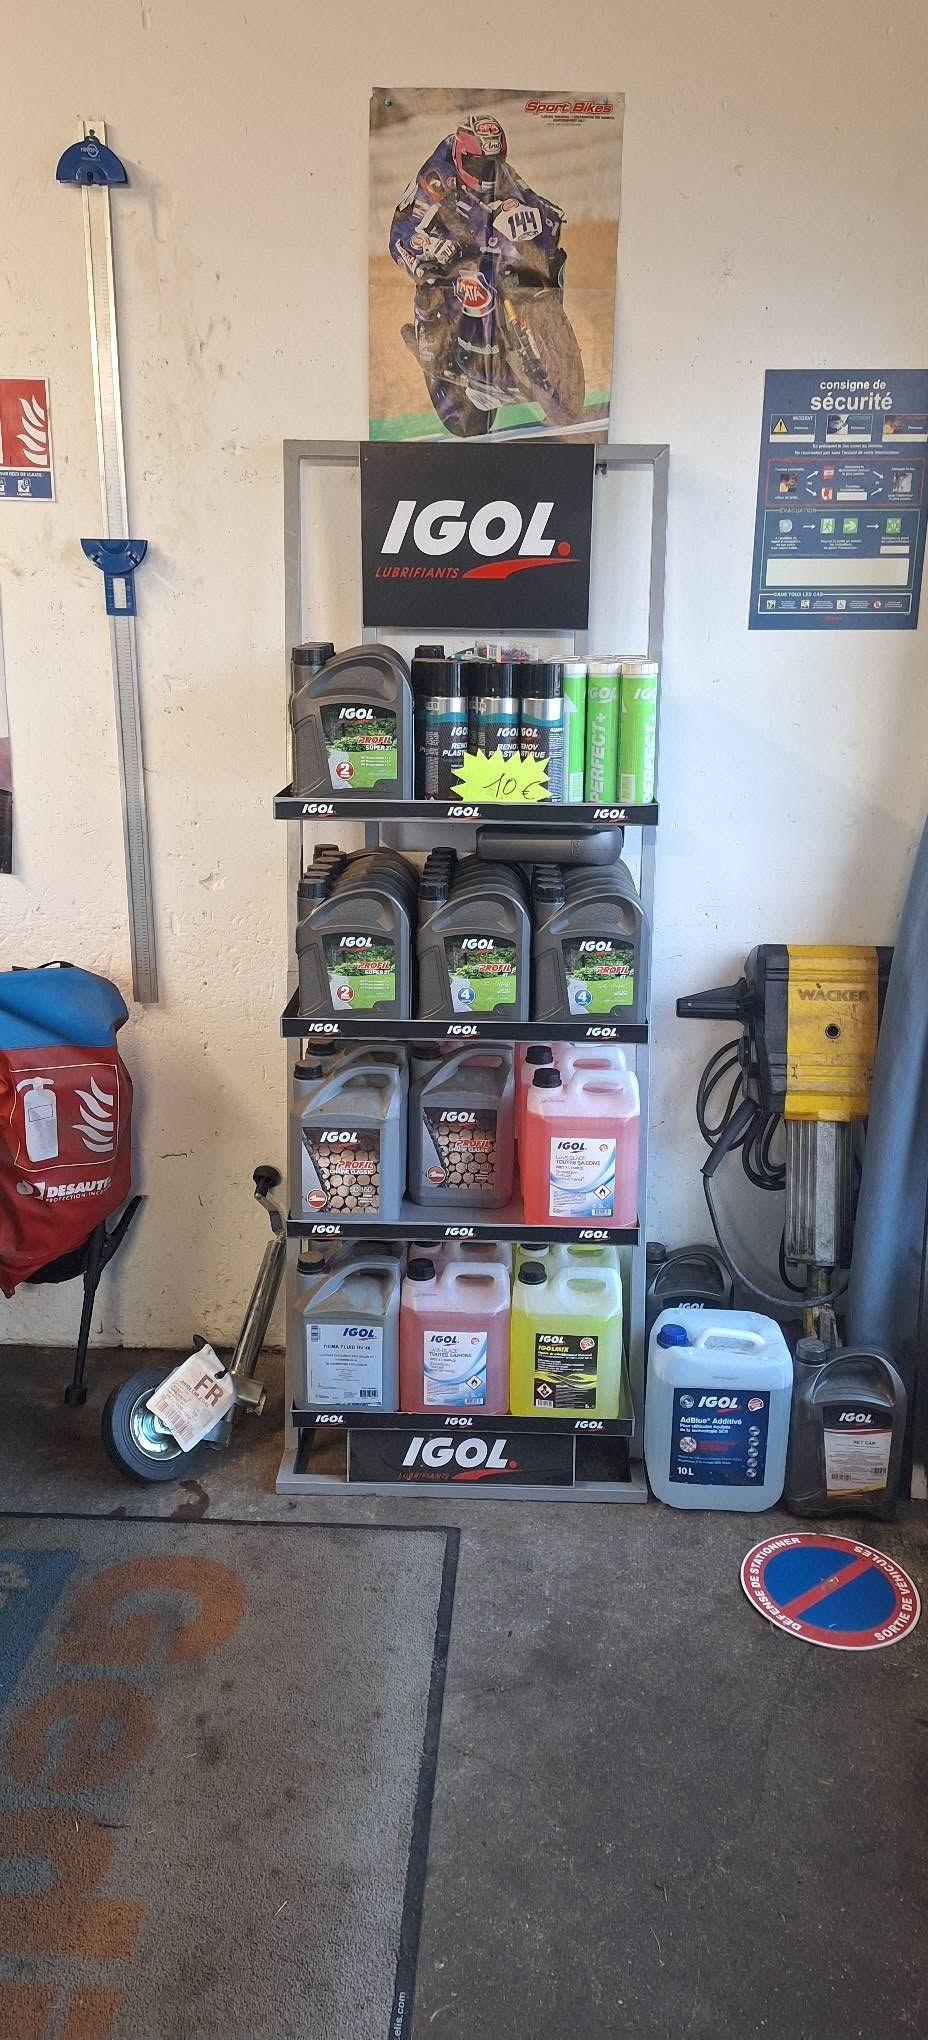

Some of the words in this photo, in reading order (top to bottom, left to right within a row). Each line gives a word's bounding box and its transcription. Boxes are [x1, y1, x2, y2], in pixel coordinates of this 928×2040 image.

[525, 100, 570, 115] Sport
[572, 101, 614, 114] Bikes
[508, 211, 538, 239] 144
[820, 379, 870, 392] consigne
[873, 379, 887, 390] de
[810, 392, 893, 411] sécurité
[375, 566, 461, 579] LUBRIFIANTS
[338, 707, 375, 720] IGOL
[357, 735, 393, 746] PROFIL
[340, 763, 351, 775] 2
[481, 772, 518, 798] 10
[520, 780, 542, 800] €
[302, 803, 334, 814] IGOL
[447, 806, 480, 817] IGOL
[593, 808, 626, 819] IGOL
[339, 936, 373, 948] IGOL
[461, 938, 495, 950] IGOL
[579, 940, 613, 952] IGOL
[357, 961, 391, 970] PROFIL
[479, 964, 512, 973] PROFIL
[596, 966, 630, 975] PROFIL
[340, 986, 351, 998] 2
[460, 988, 471, 1000] 4
[577, 990, 588, 1002] 4
[797, 989, 870, 1002] WACKER
[308, 1022, 339, 1033] IGOL
[446, 1025, 478, 1035] IGOL
[586, 1027, 617, 1037] IGOL
[440, 1111, 477, 1123] IGOL
[320, 1131, 358, 1143] IGOL
[557, 1141, 585, 1151] IGOL
[336, 1160, 374, 1169] PROFIL
[311, 1224, 341, 1234] IGOL
[444, 1227, 475, 1237] IGOL
[578, 1230, 609, 1240] IGOL
[342, 1327, 375, 1338] IGOL
[430, 1335, 457, 1344] IGOL
[538, 1335, 564, 1344] IGOL
[538, 1345, 570, 1353] IGOLMIX
[193, 1374, 224, 1408] FR
[697, 1396, 739, 1409] IGOL
[315, 1414, 344, 1424] IGOL
[444, 1417, 474, 1427] IGOL
[839, 1412, 872, 1424] IGOL
[574, 1420, 604, 1430] IGOL
[398, 1471, 450, 1481] LUBRIFIANTS
[677, 1466, 687, 1475] 10
[749, 1536, 802, 1575] STATIONNER
[750, 1575, 760, 1589] DE
[873, 1613, 911, 1642] SORTIE
[901, 1597, 913, 1612] DE
